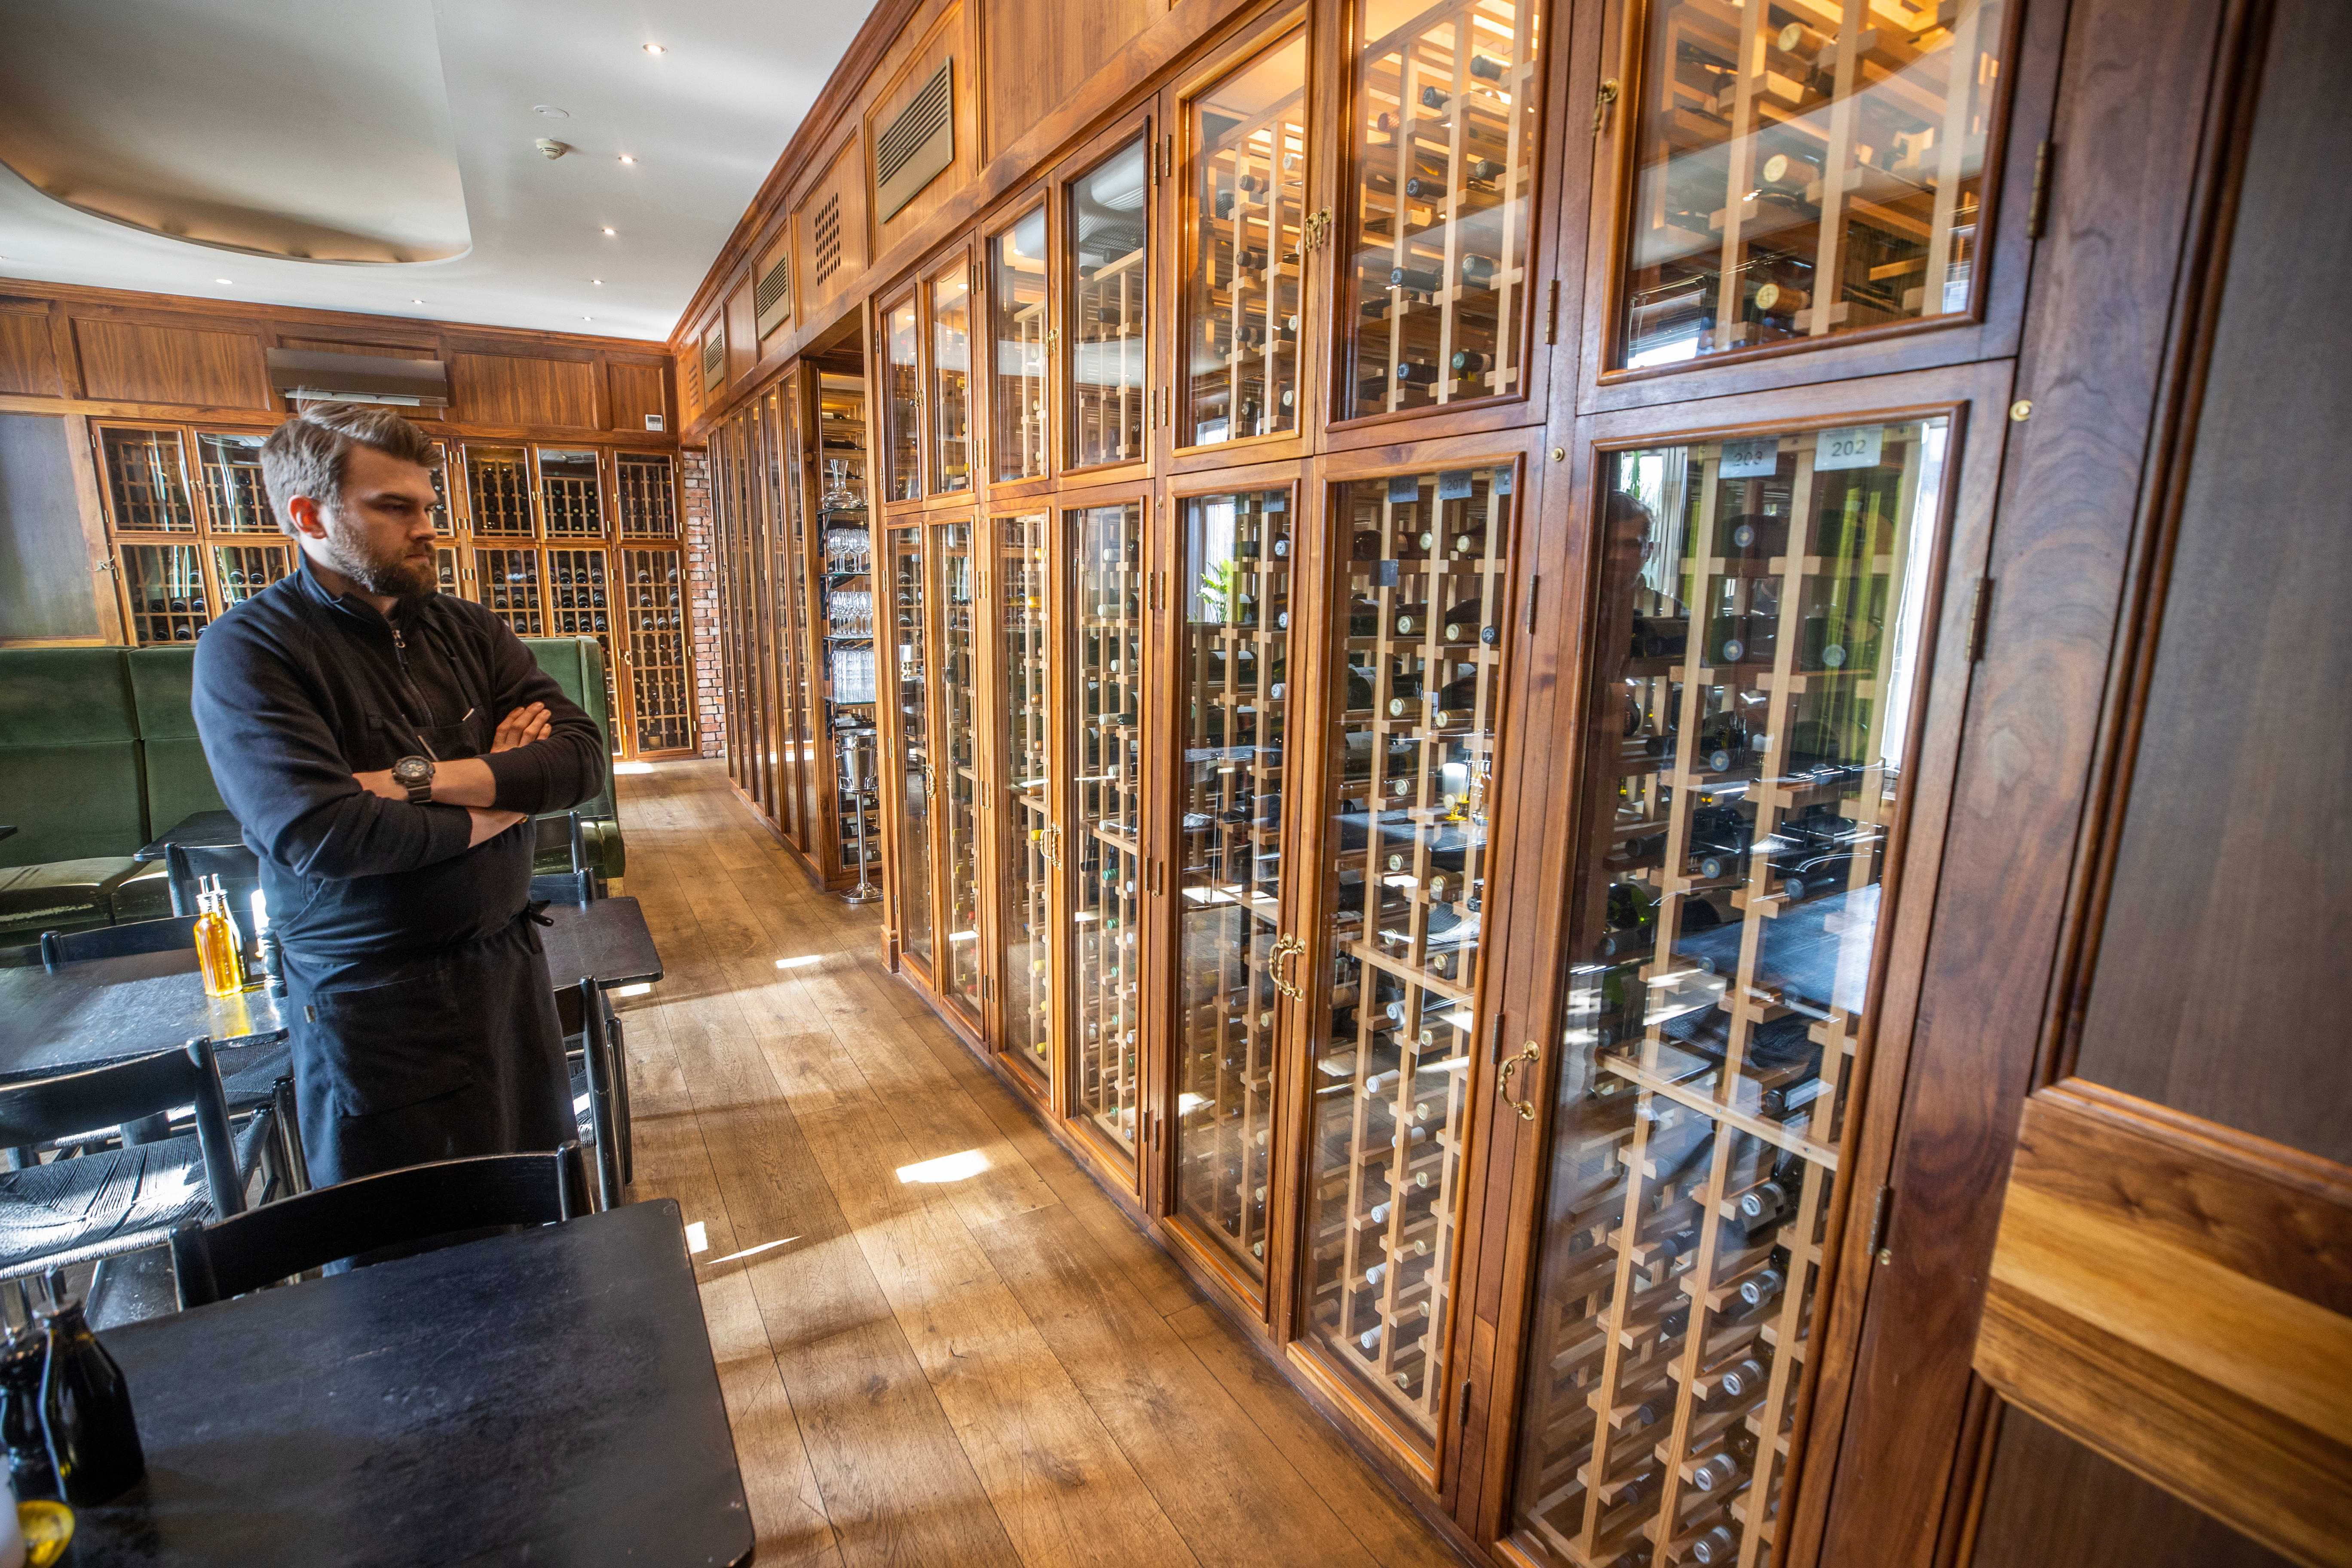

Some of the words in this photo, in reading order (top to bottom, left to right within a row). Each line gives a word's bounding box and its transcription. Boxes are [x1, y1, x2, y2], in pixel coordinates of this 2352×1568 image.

[1831, 440, 1867, 458] 202
[1733, 451, 1763, 467] 203
[1447, 478, 1465, 491] 207
